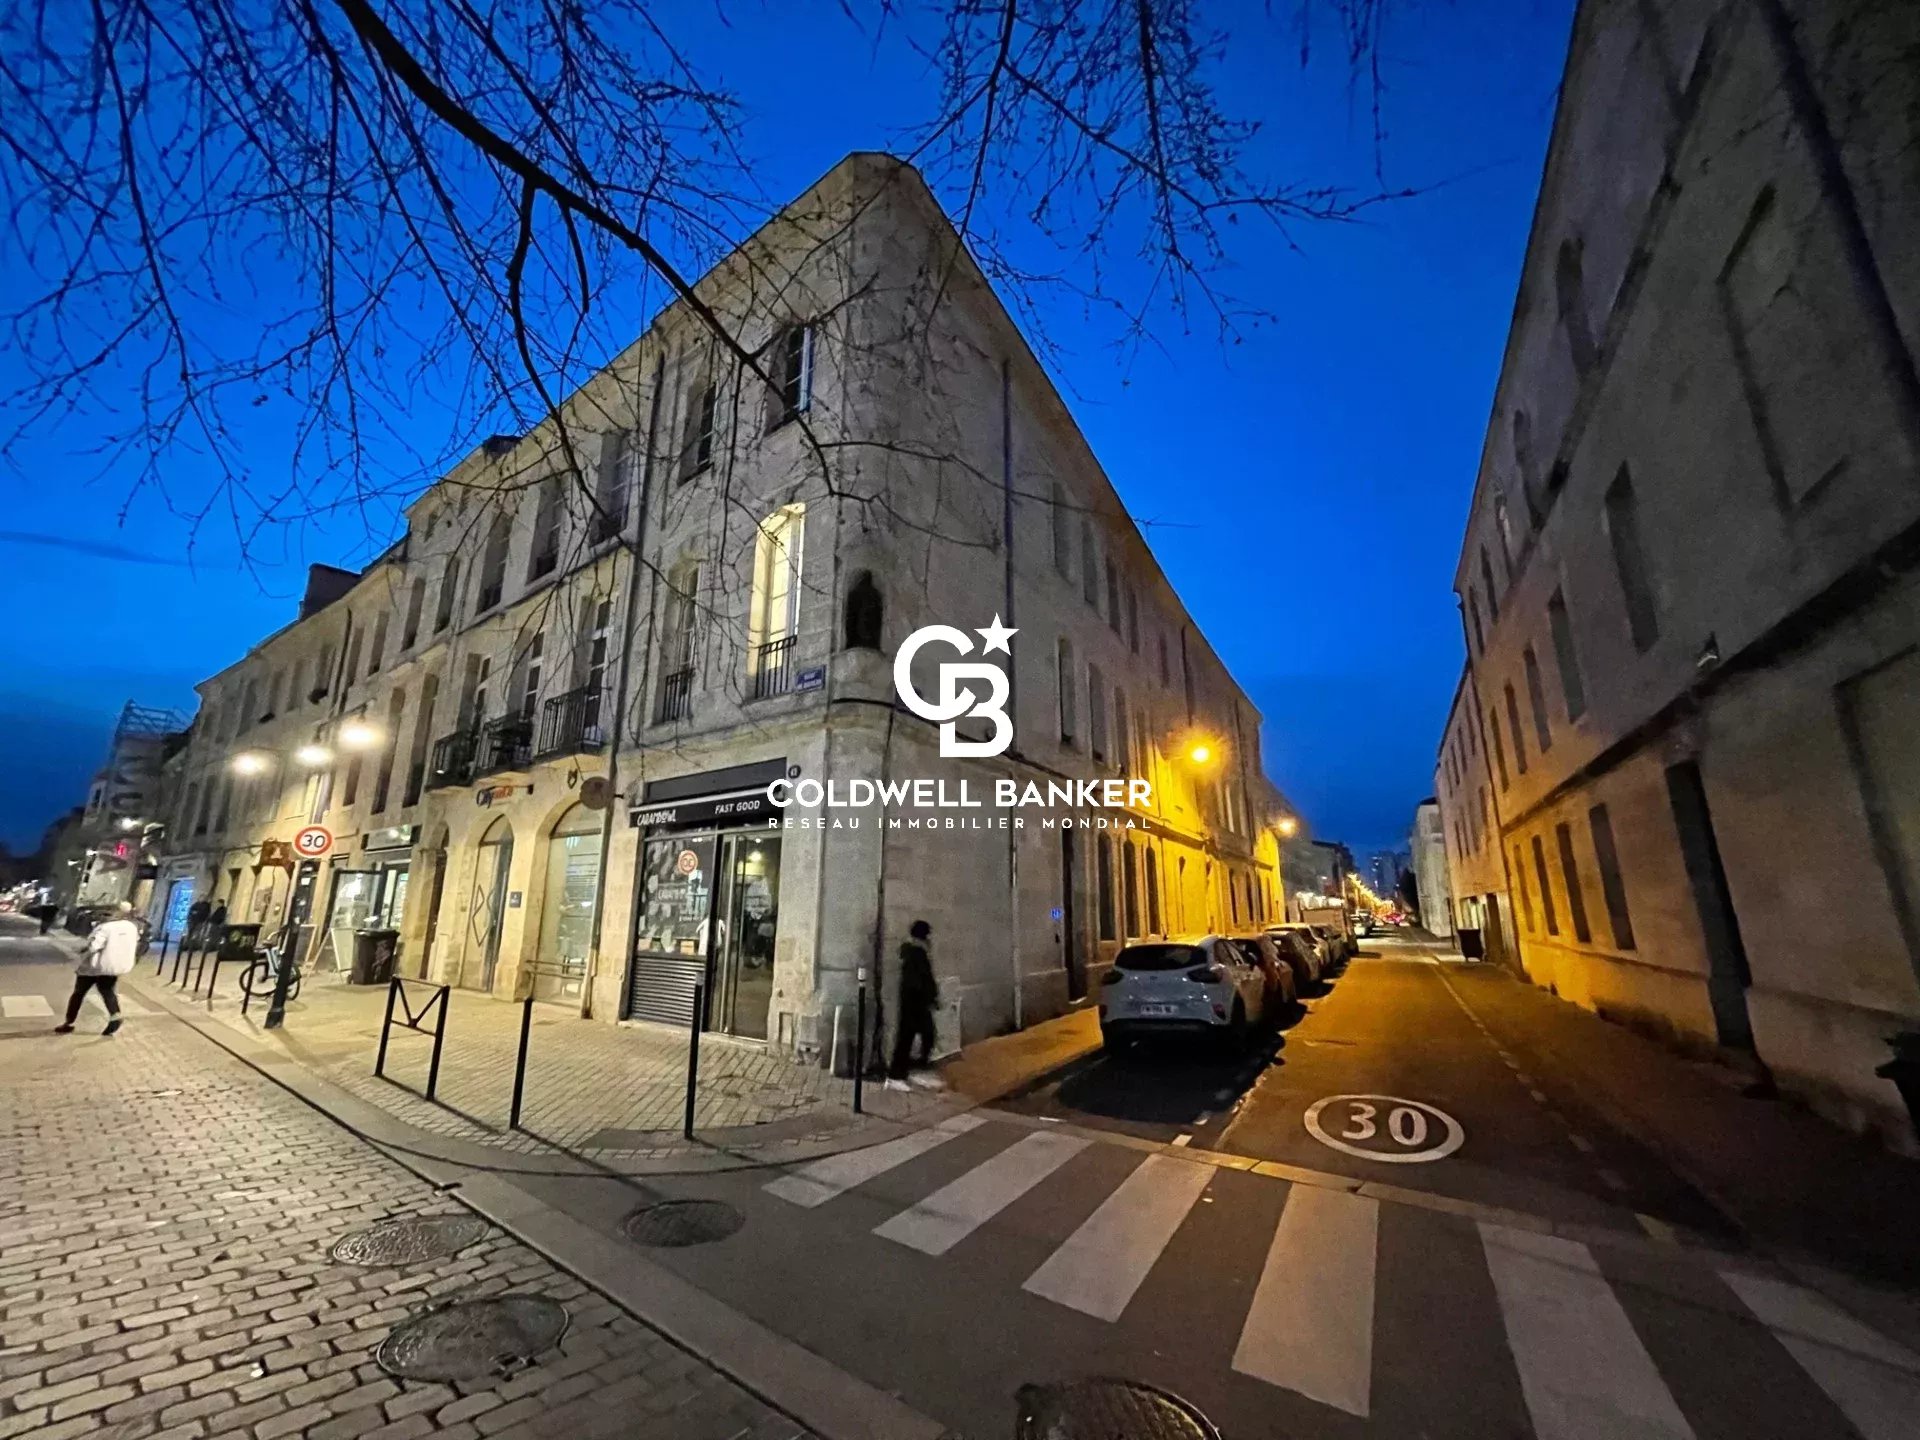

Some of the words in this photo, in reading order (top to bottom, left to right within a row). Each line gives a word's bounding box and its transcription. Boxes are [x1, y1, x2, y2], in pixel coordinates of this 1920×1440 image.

[714, 803, 735, 815] FAST
[736, 800, 760, 812] GOOD
[302, 834, 326, 848] 30
[1341, 1101, 1428, 1147] 30
